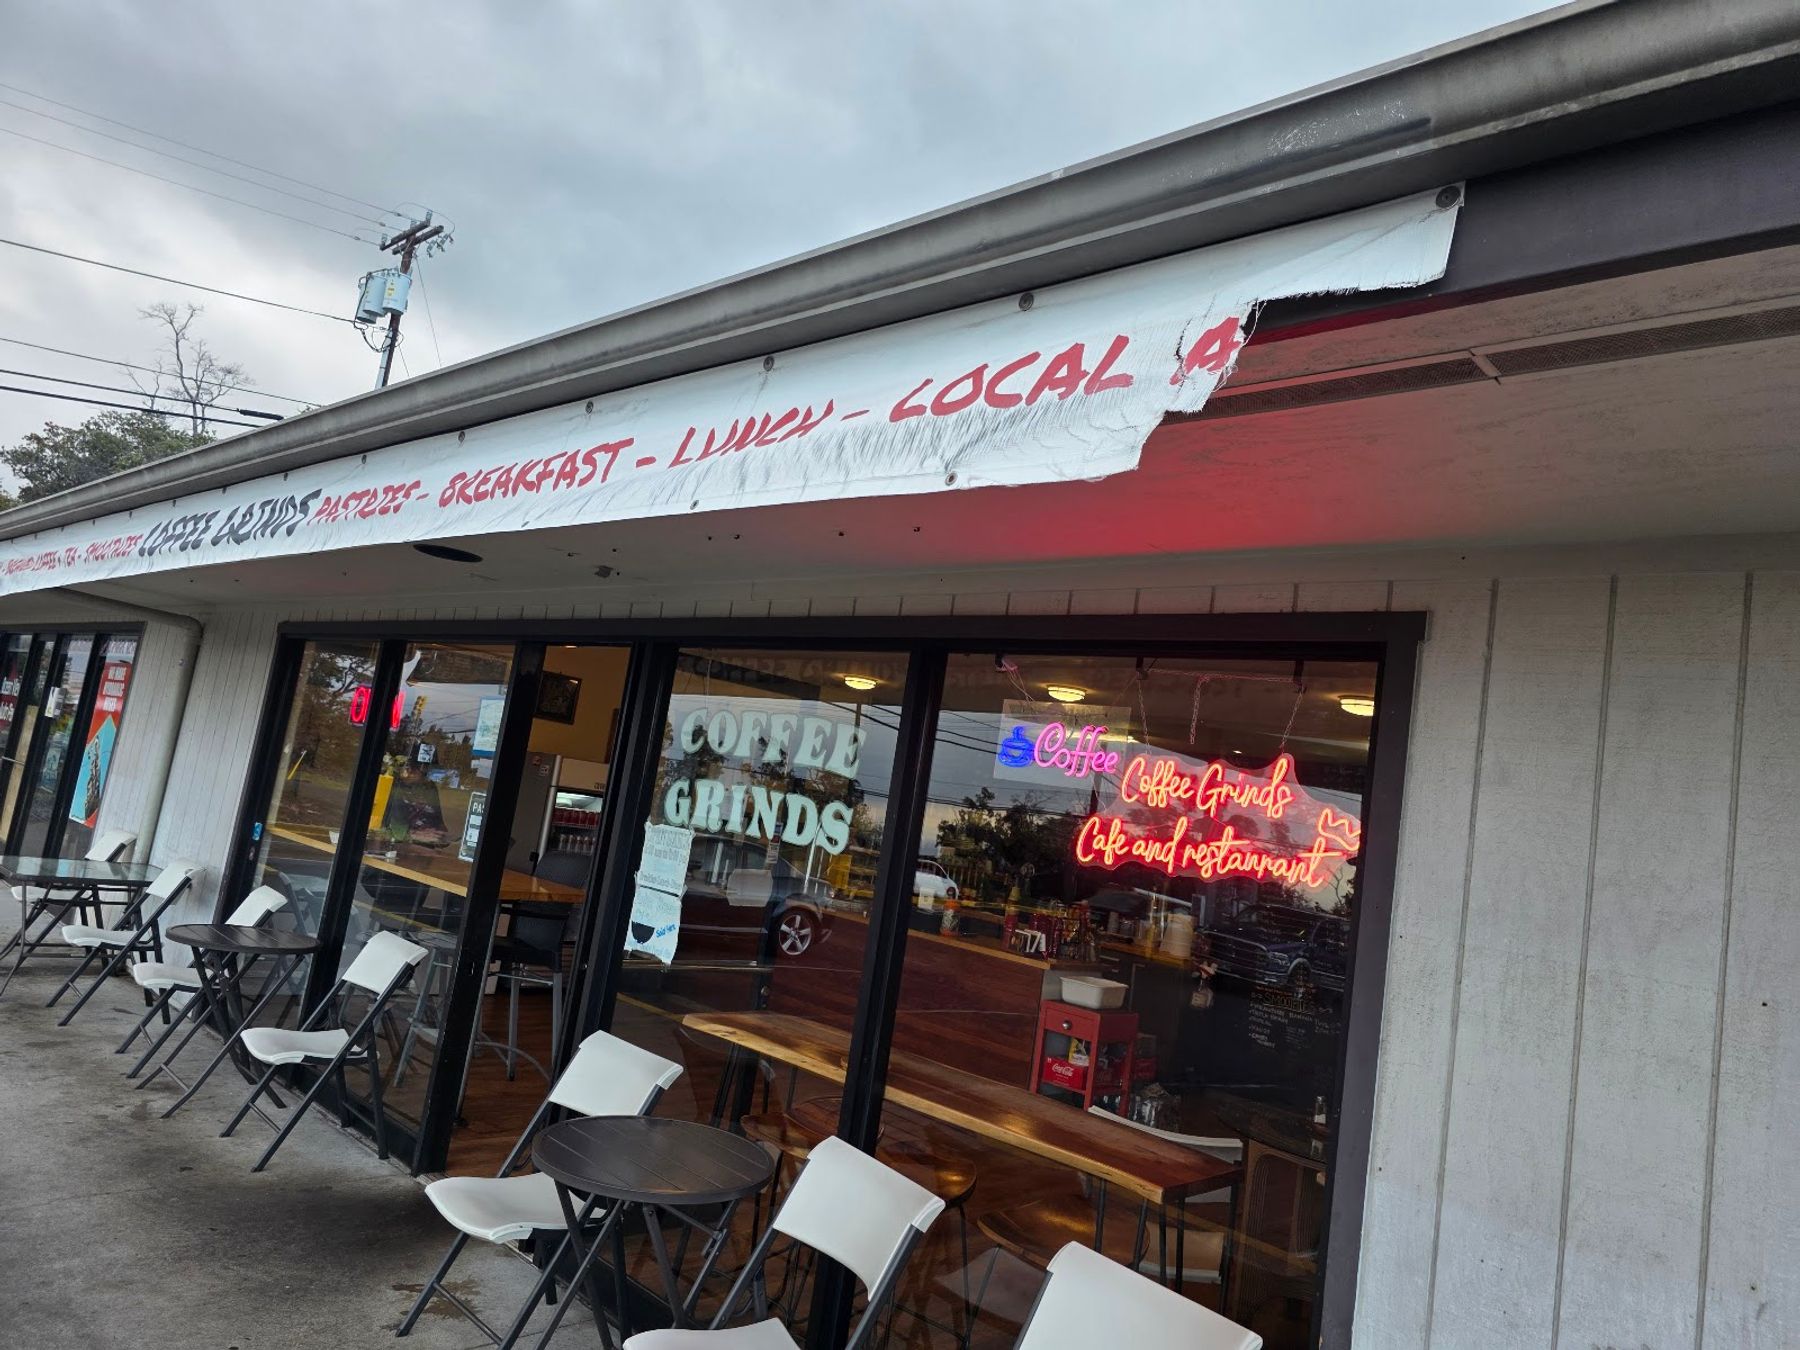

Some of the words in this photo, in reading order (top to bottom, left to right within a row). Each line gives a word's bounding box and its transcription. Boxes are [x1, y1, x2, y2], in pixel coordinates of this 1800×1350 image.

[138, 509, 220, 557] COFFEE
[211, 488, 322, 546] GRINDS
[306, 479, 421, 525] PASTRIES
[438, 437, 635, 508] BREAKFAST
[669, 399, 834, 469] LUNCH
[889, 335, 1134, 423] LOCAL
[680, 707, 867, 780] COFFEE
[1033, 722, 1119, 778] Coffee
[664, 779, 854, 856] GRINDS
[1121, 756, 1195, 808] Coffee
[1196, 757, 1293, 818] Grinds
[1075, 816, 1129, 865] Cafe
[1132, 816, 1188, 873] and
[1182, 825, 1342, 888] restaurant
